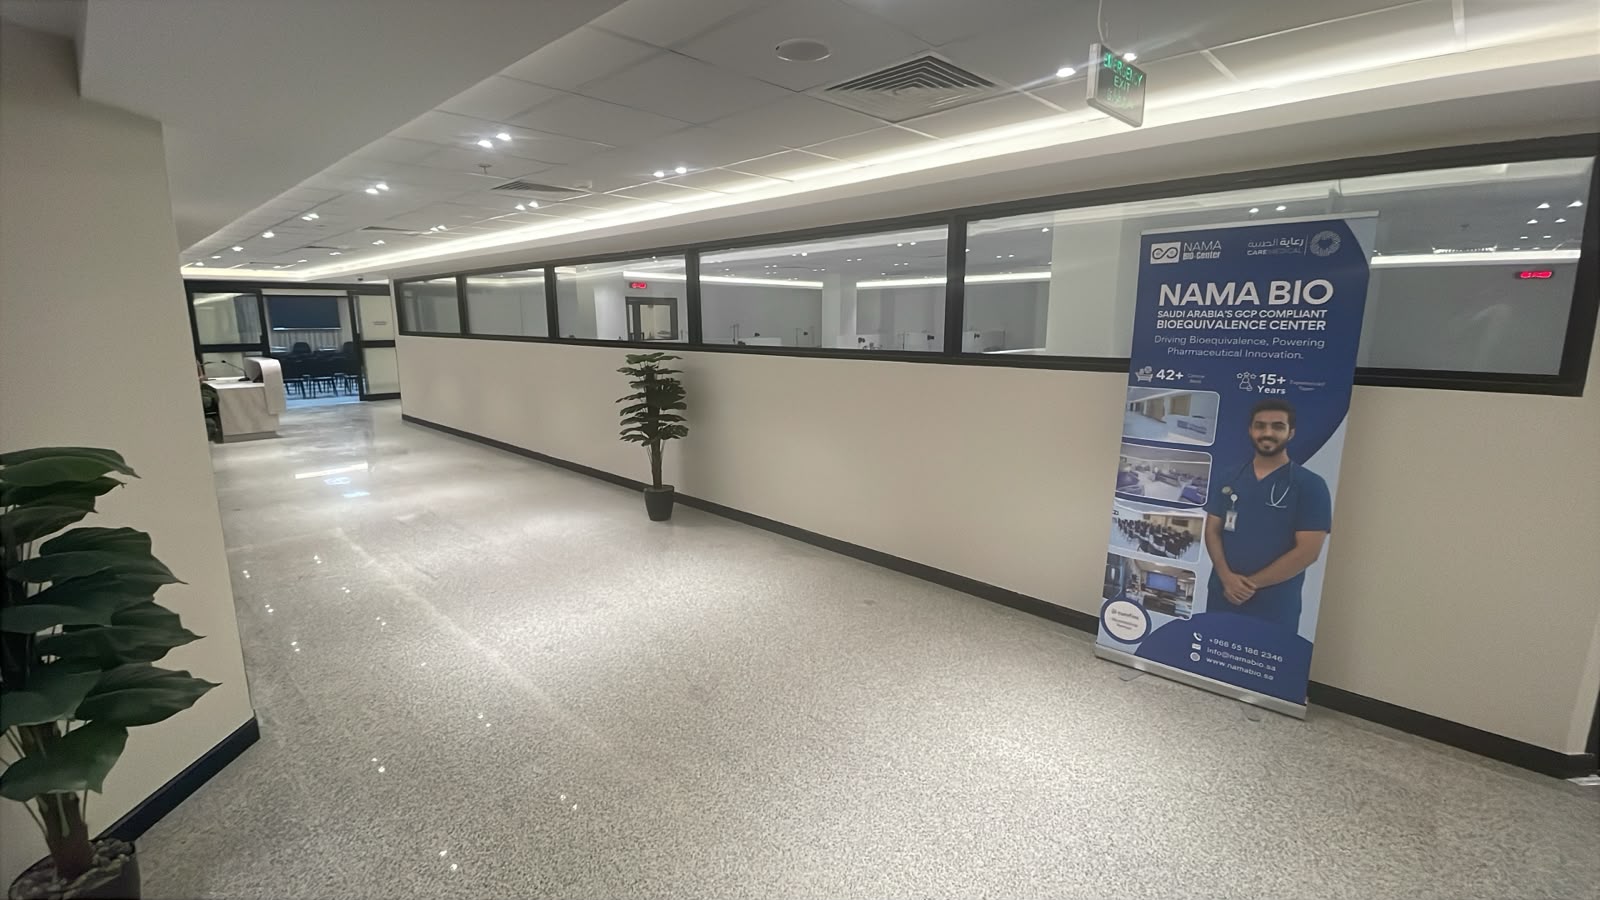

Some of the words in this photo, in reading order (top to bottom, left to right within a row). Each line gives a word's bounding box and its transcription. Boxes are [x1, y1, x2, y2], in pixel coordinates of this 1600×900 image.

[1113, 75, 1131, 93] EXIT
[1183, 240, 1222, 252] NAMA
[1158, 281, 1260, 307] NAMA
[1268, 279, 1334, 305] BIO
[1157, 310, 1185, 318] SAUDI
[1186, 310, 1233, 318] ARABIA'S
[1234, 309, 1258, 318] GCP
[1258, 309, 1328, 319] COMPLIANT
[1156, 319, 1267, 330] BIOEQUIVALENCE
[1269, 320, 1327, 331] CENTER
[1154, 335, 1187, 346] Driving
[1189, 335, 1269, 346] Bioequivalence,
[1272, 337, 1325, 349] Powering
[1167, 347, 1242, 358] Pharmaceutical
[1245, 349, 1304, 360] Innovation.
[1155, 369, 1184, 381] 42+
[1259, 373, 1286, 385] 15+
[1257, 385, 1286, 395] Years
[1231, 643, 1242, 651] 55
[1244, 646, 1259, 656] 186
[1260, 651, 1283, 663] 2346
